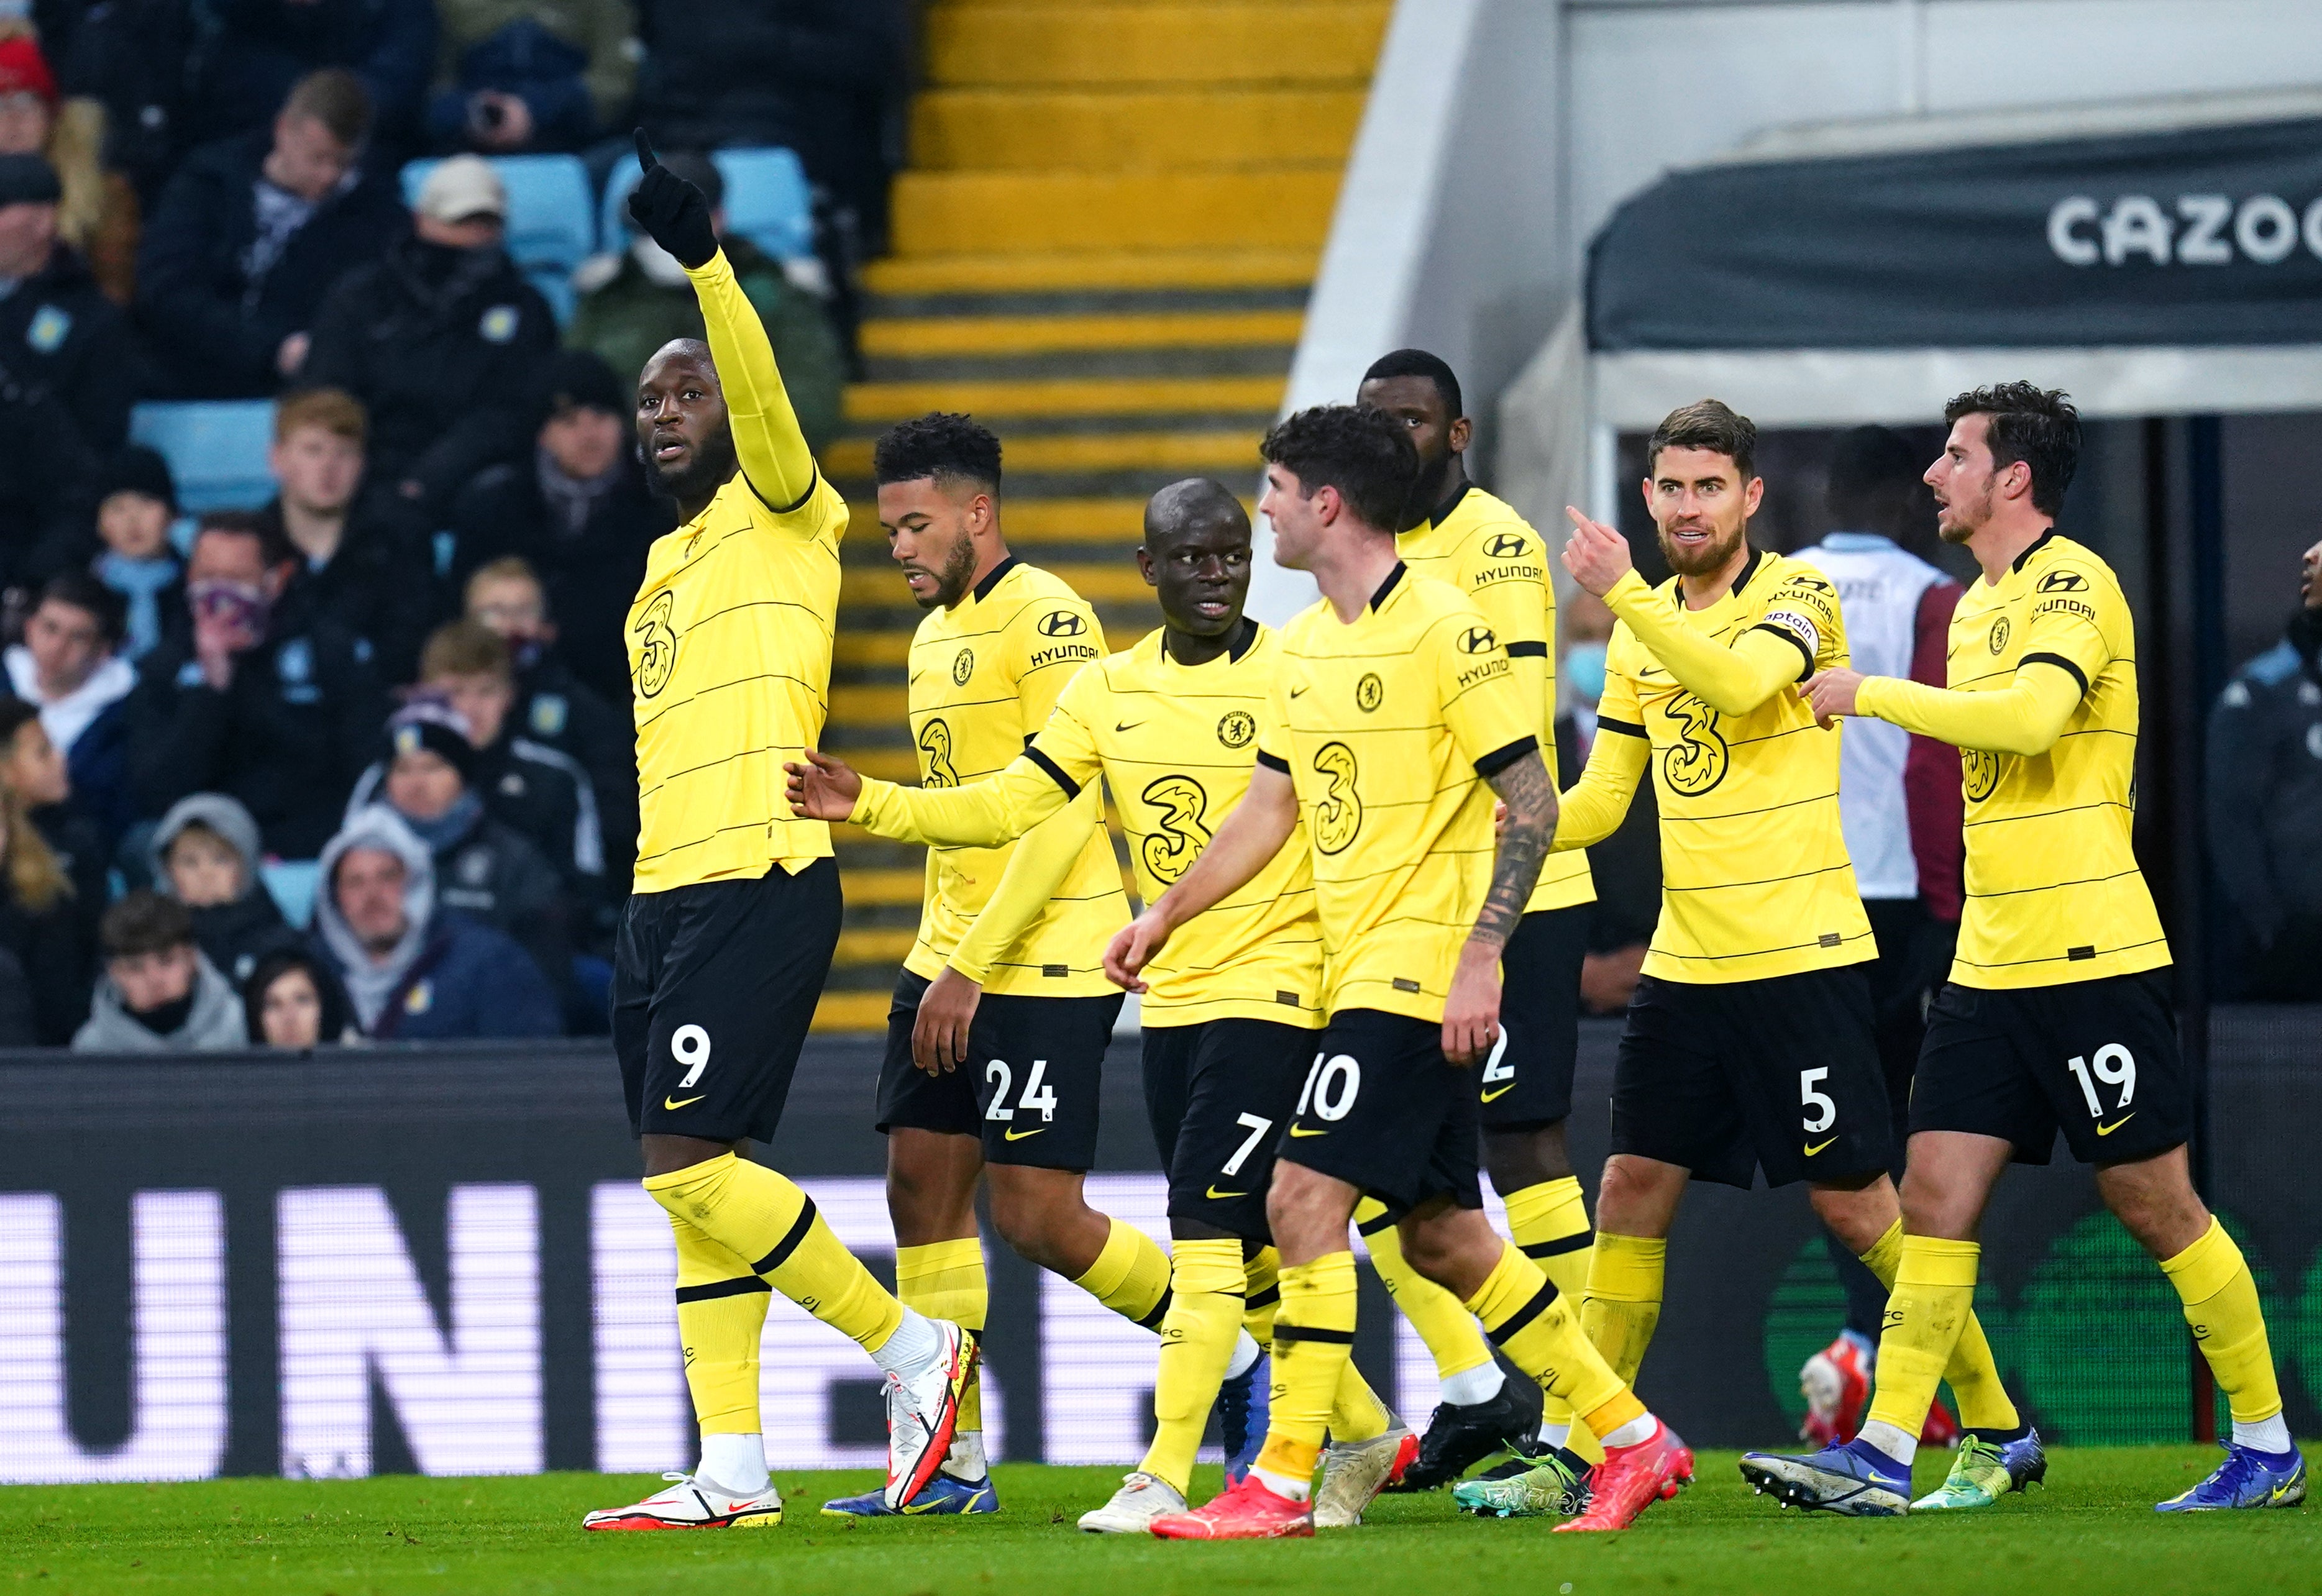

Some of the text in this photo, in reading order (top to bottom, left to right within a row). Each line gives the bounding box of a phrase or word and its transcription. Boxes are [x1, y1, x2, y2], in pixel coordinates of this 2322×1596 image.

[2052, 200, 2322, 258] CAZO
[1475, 565, 1543, 585] HYUNDAI
[1767, 590, 1835, 624] HYUNDAI
[1030, 644, 1099, 667] HYUNDAI
[671, 1024, 711, 1088] 9
[1296, 1052, 1361, 1121] 10
[2068, 1043, 2136, 1118] 19
[985, 1059, 1058, 1122] 24
[1801, 1066, 1835, 1133] 5
[1221, 1112, 1273, 1176] 7
